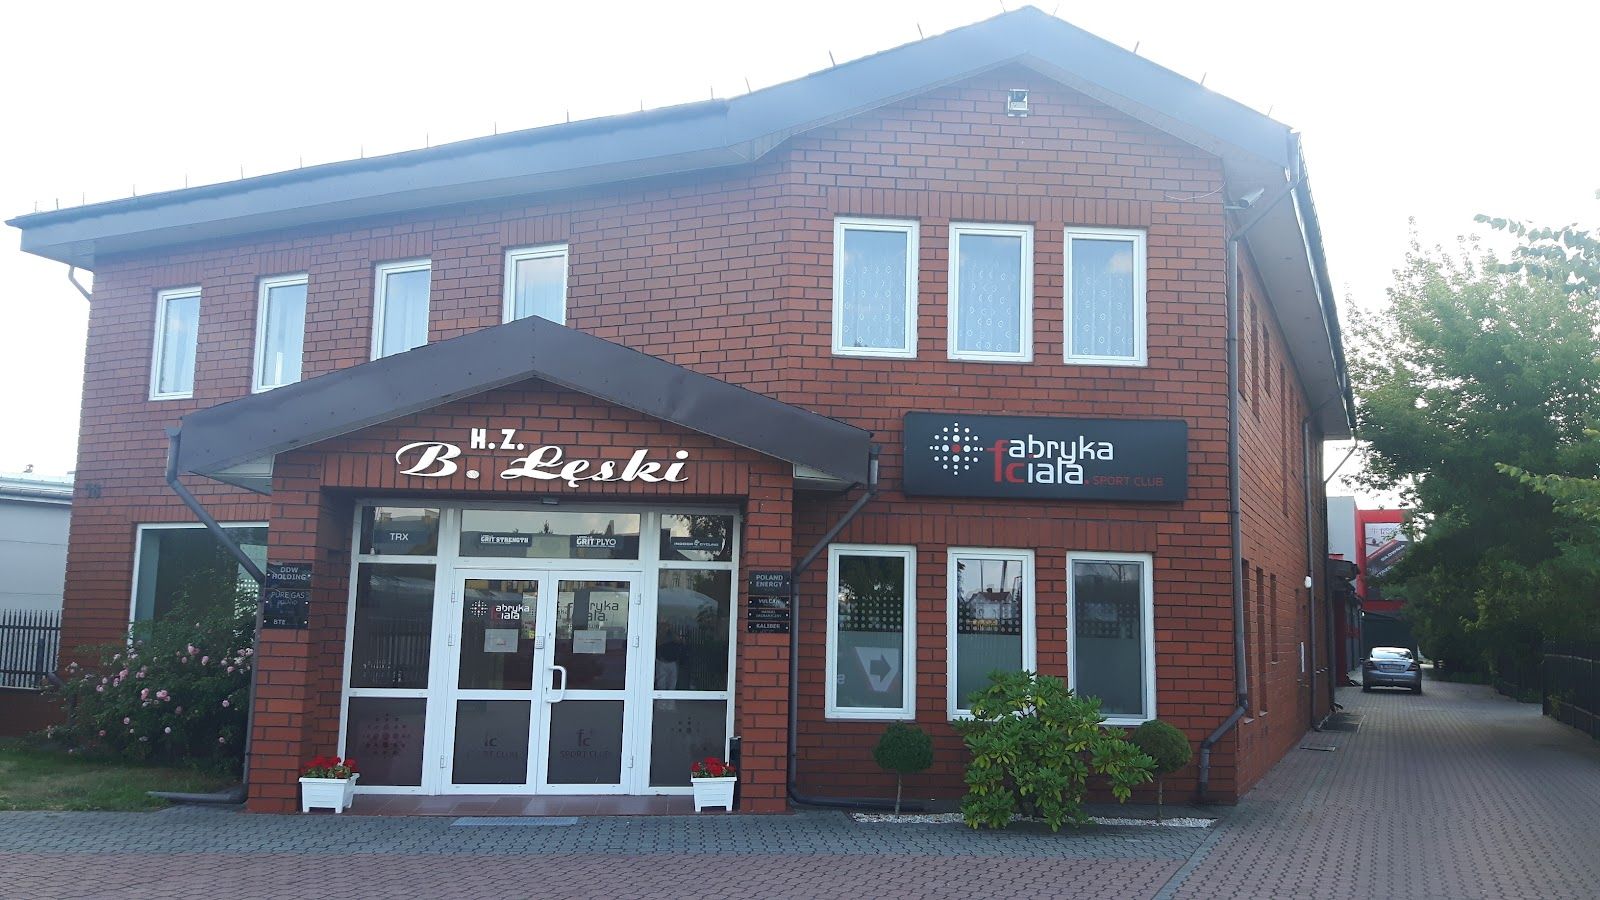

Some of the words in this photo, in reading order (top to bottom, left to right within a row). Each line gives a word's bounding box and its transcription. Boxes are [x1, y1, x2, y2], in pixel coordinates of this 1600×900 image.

[987, 434, 1114, 482] fabryka
[395, 441, 480, 479] B.
[500, 446, 689, 488] Łęski
[1093, 475, 1129, 486] SPORT
[1134, 477, 1164, 487] CLUB
[389, 532, 409, 541] TRX
[480, 535, 495, 543] GRIT
[576, 538, 594, 546] GRIT
[596, 538, 616, 546] PLYO
